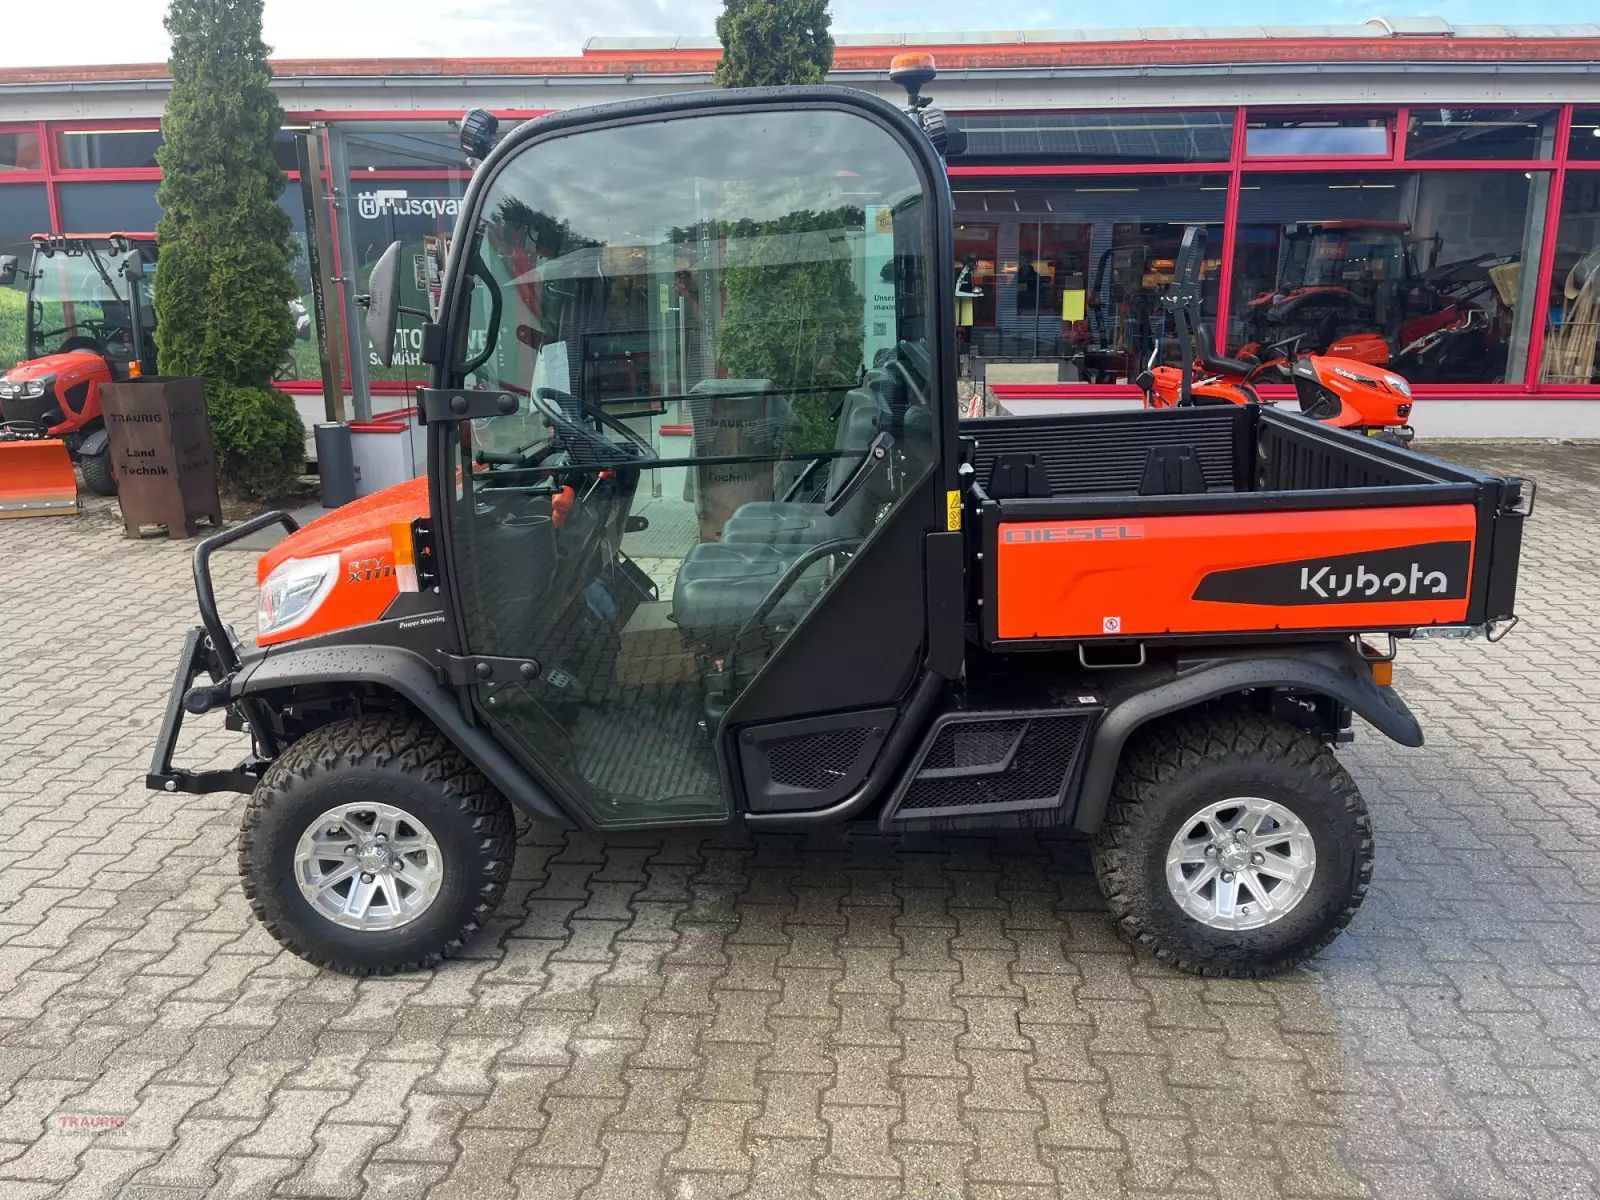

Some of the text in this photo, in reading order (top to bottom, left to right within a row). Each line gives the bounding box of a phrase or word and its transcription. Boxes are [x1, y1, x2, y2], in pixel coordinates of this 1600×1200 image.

[109, 413, 162, 423] TRAURIG
[126, 447, 155, 458] Land
[120, 464, 168, 476] Technik
[1005, 525, 1143, 544] DIESEL
[348, 556, 385, 573] RTV
[346, 564, 397, 584] X111
[1300, 562, 1448, 598] Kubota
[399, 620, 420, 629] Power
